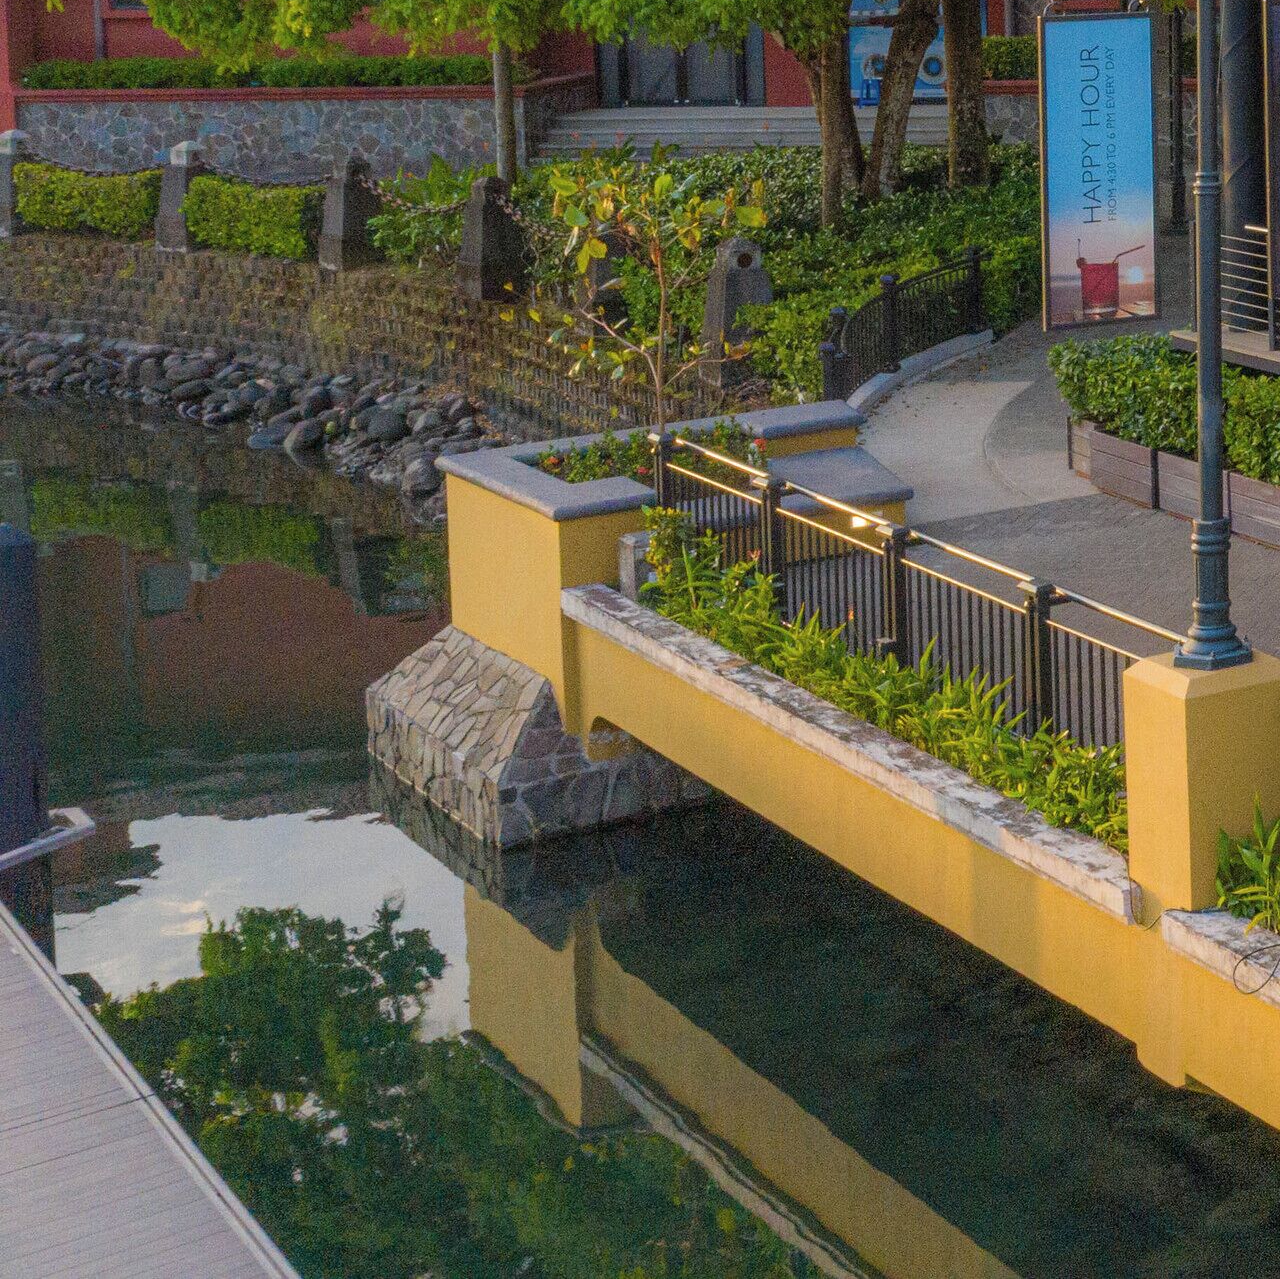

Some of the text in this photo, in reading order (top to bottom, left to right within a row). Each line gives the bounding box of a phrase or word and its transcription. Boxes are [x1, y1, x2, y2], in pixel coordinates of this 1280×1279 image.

[1104, 45, 1115, 70] DAY
[1105, 74, 1116, 109] EVERY
[1080, 42, 1101, 224] HAPPY HOUR
[1106, 112, 1116, 129] PM
[1106, 143, 1116, 161] TO
[1106, 162, 1117, 184] 4:30
[1107, 188, 1117, 221] FROM
